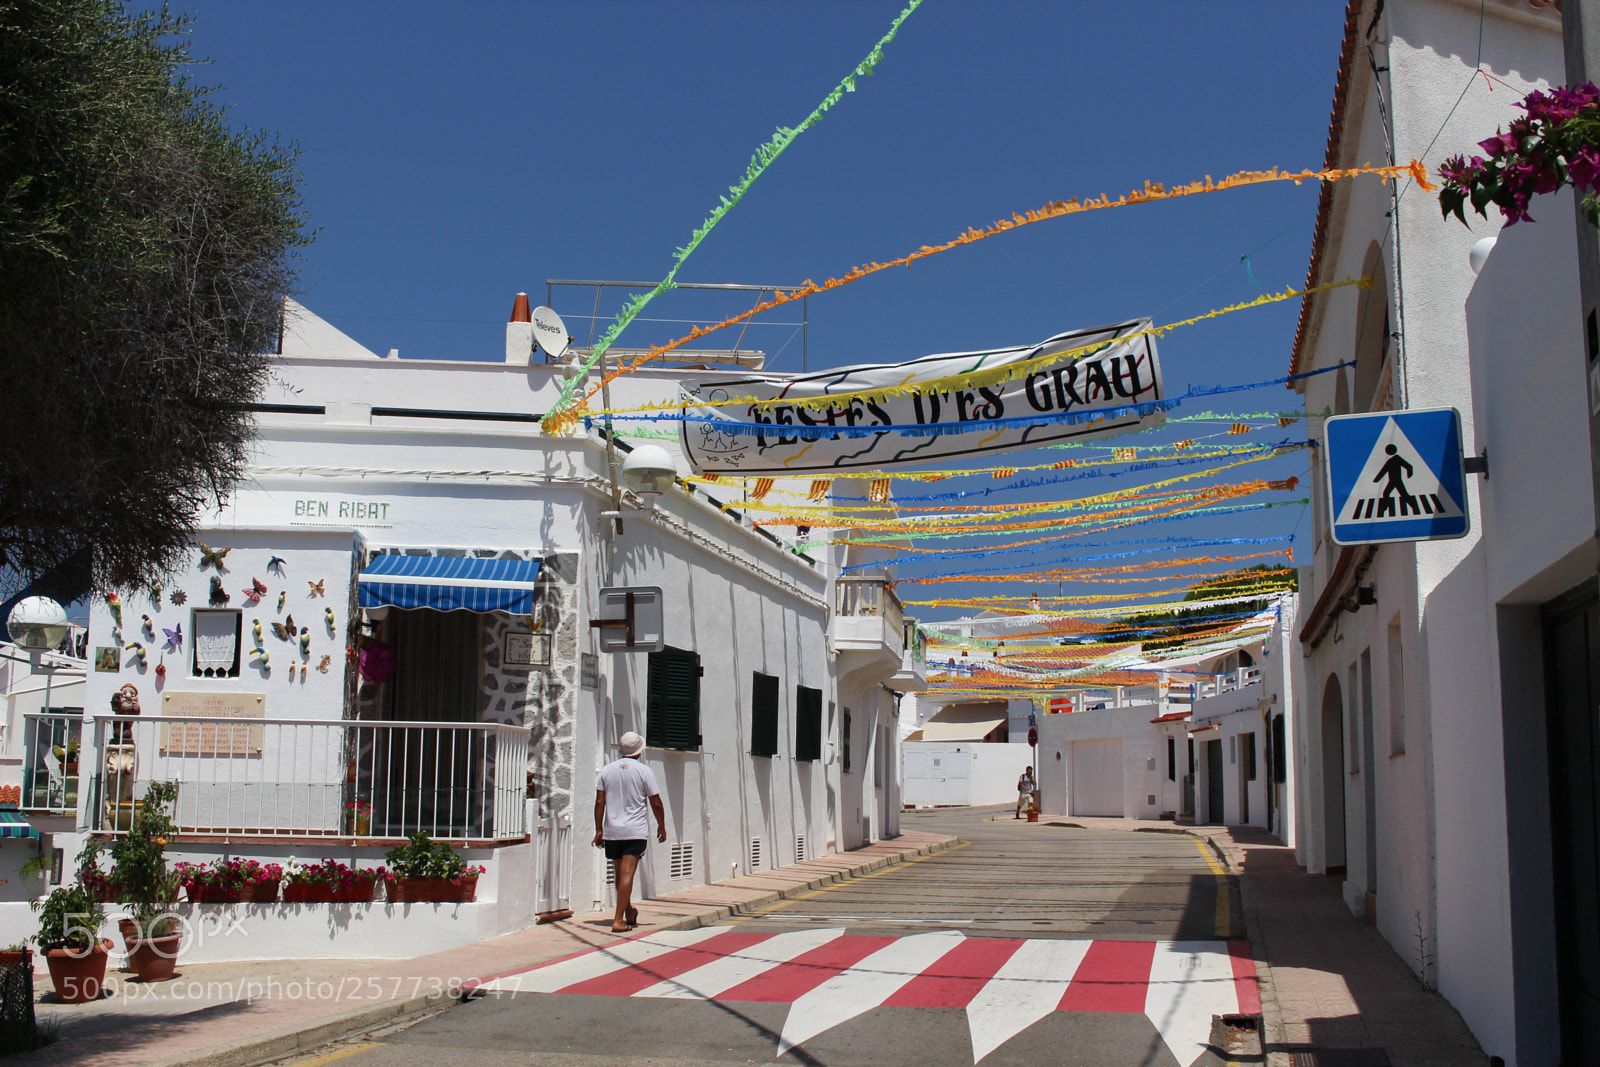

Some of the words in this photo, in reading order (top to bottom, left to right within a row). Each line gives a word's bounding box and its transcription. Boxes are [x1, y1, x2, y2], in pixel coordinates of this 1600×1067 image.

[534, 318, 561, 334] Televes
[1024, 354, 1144, 413] GRAU
[294, 500, 329, 518] BEN
[338, 501, 390, 520] RIBAT
